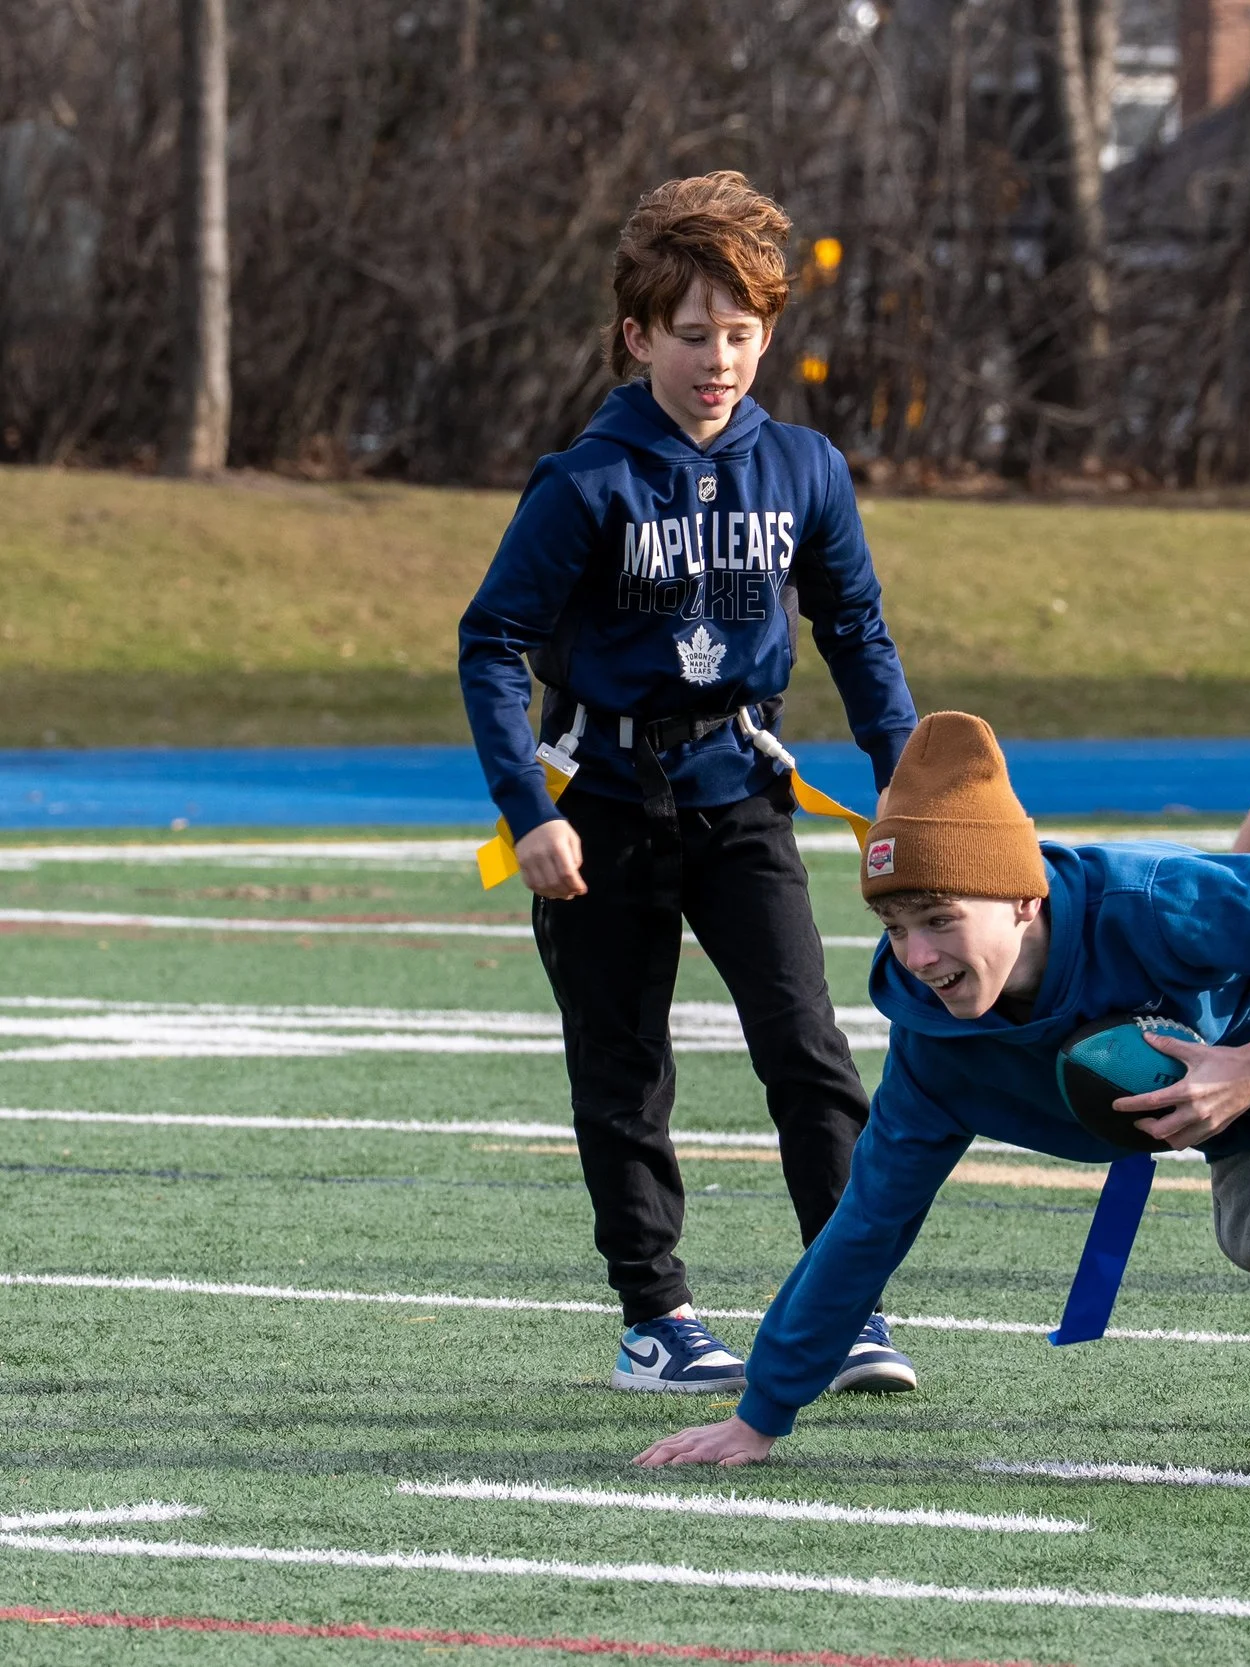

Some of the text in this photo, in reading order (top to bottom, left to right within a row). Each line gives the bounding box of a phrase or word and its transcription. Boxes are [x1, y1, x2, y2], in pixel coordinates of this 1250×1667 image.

[623, 511, 794, 579] MAPLE LEAFS
[618, 569, 789, 620] HOCKEY
[685, 652, 717, 663] TORONTO
